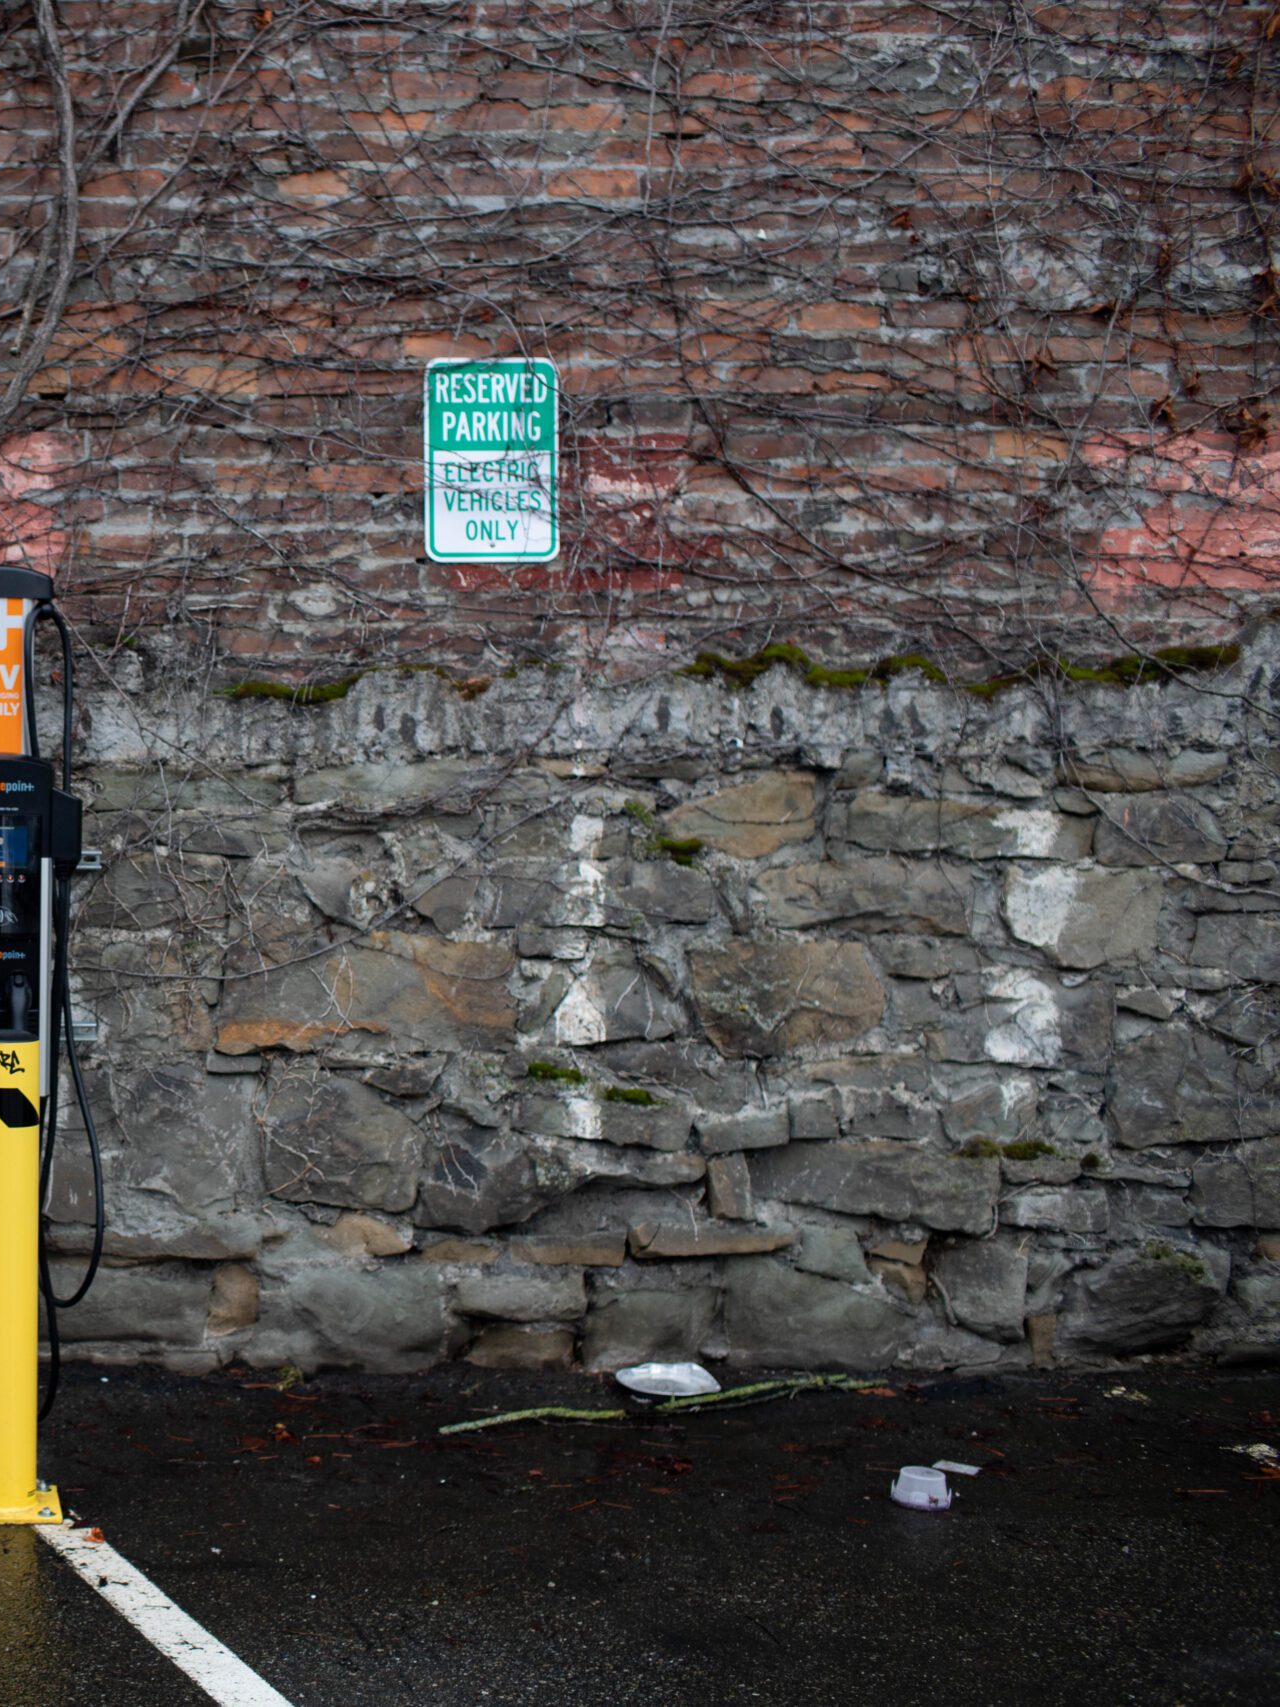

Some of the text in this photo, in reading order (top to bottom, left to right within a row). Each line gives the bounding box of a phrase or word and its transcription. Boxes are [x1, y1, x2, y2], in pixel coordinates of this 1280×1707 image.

[435, 373, 548, 404] RESERVED
[442, 411, 541, 442] PARKING
[444, 461, 540, 483] ELECTRIC
[443, 490, 542, 512] VEHICLES
[465, 519, 519, 541] ONLY
